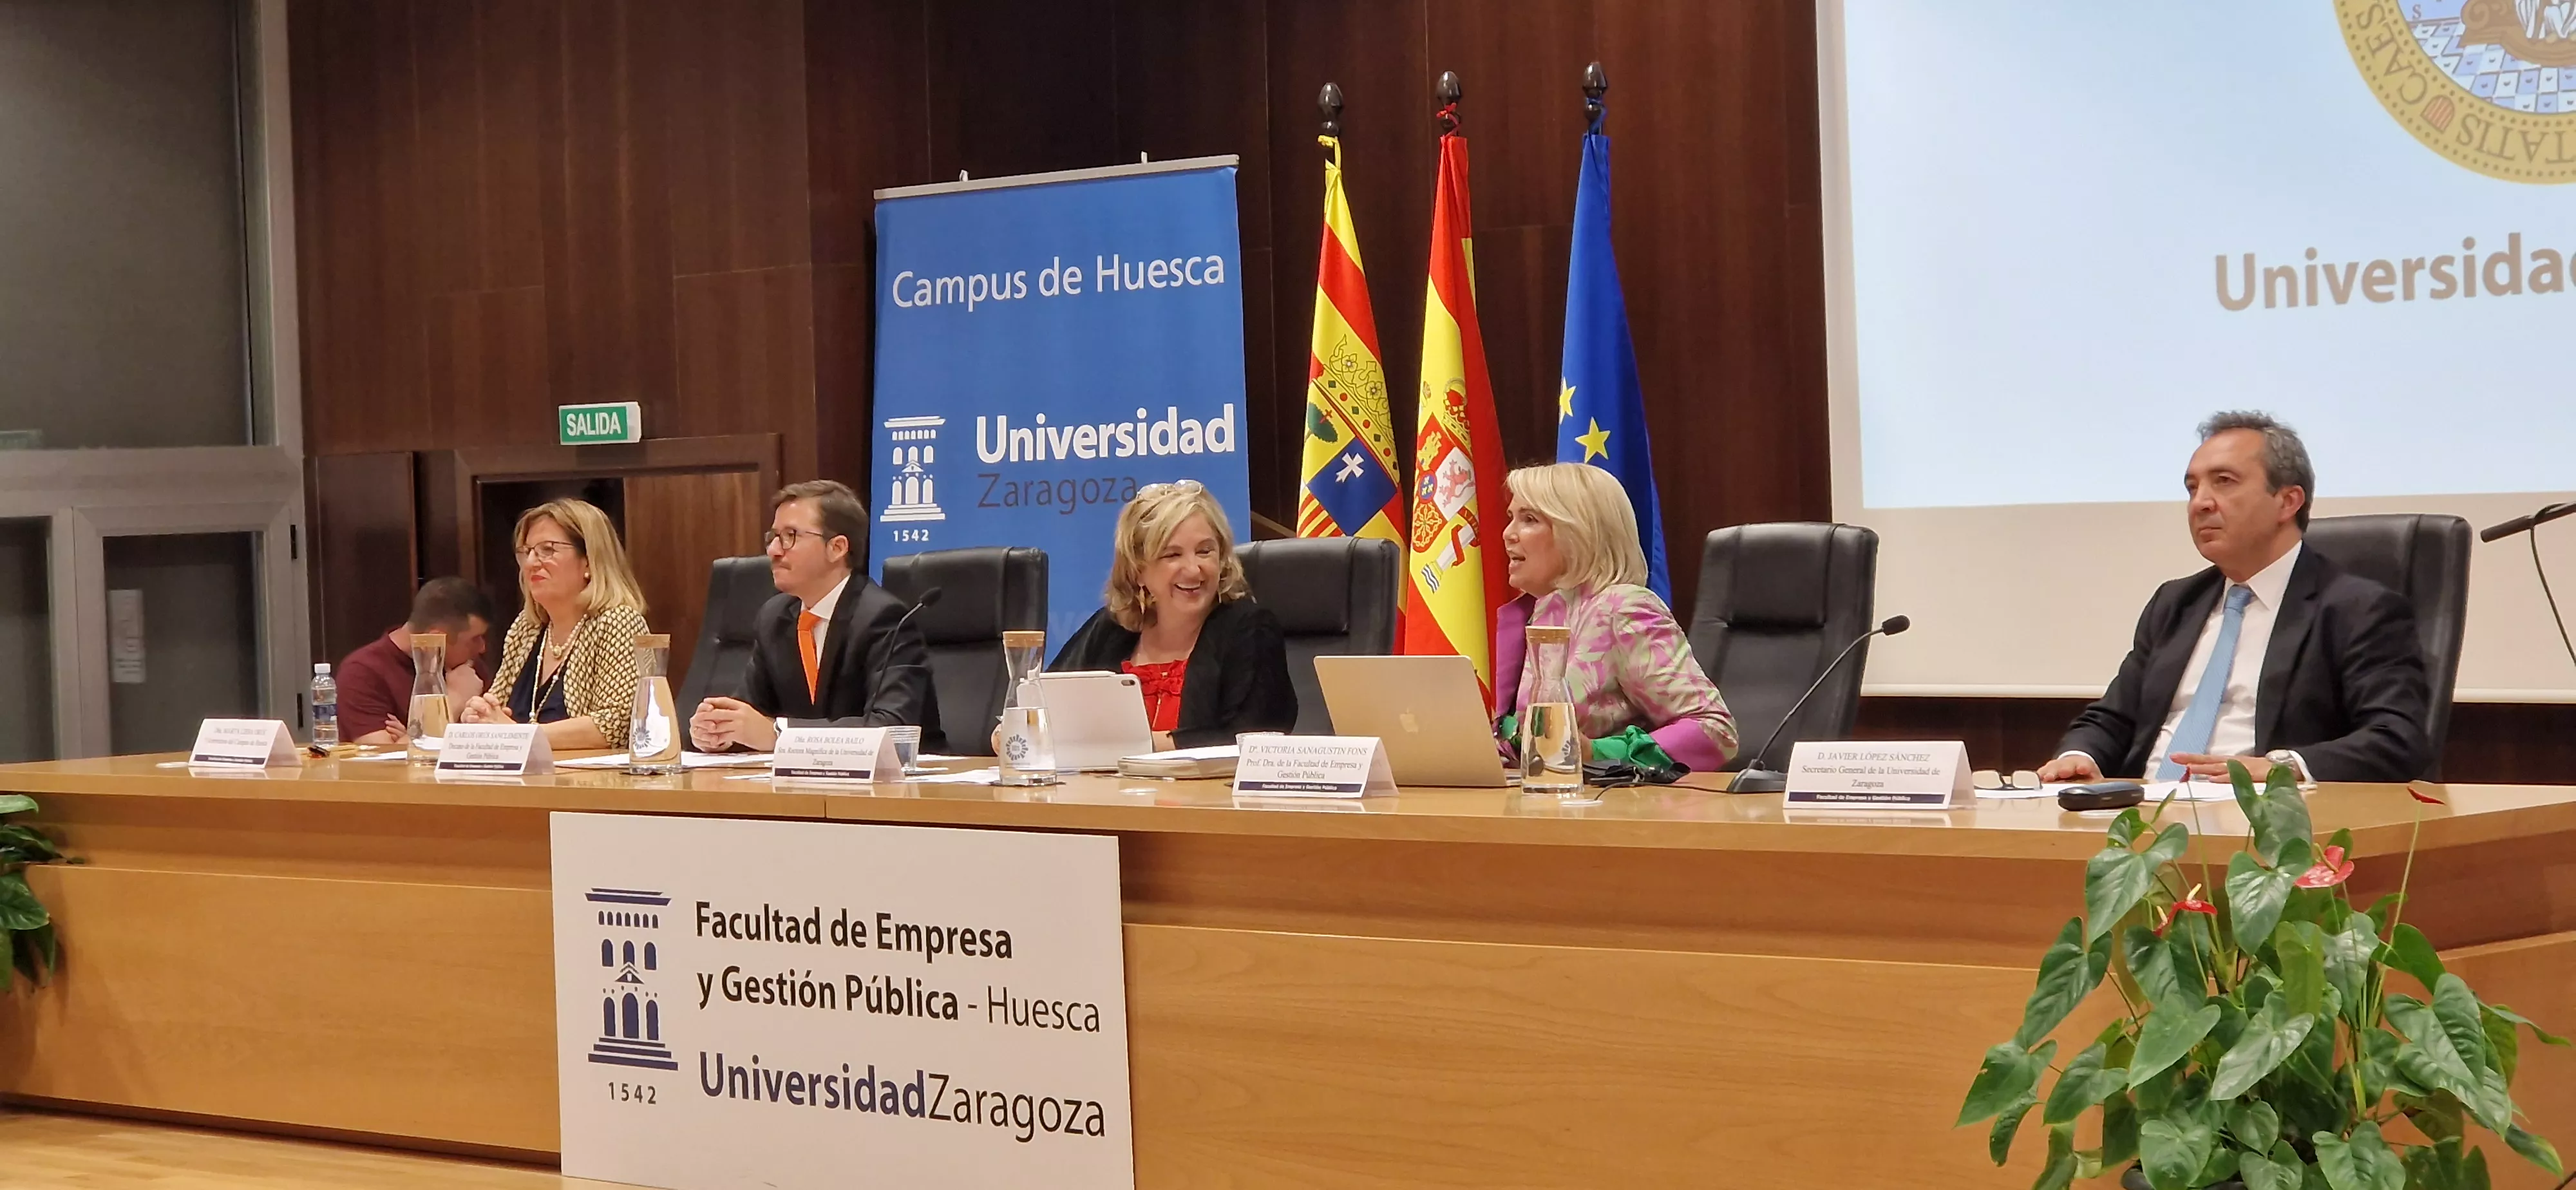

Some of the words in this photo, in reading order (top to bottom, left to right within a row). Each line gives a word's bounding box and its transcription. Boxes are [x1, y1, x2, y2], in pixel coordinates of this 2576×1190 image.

[893, 270, 1027, 312] Campus
[1038, 256, 1083, 297] de
[1097, 254, 1224, 292] Huesca
[2215, 232, 2576, 311] Universida
[566, 411, 621, 437] SALIDA
[976, 403, 1235, 464] Universidad
[978, 473, 1137, 515] Zaragoza
[893, 529, 929, 542] 1542
[1260, 746, 1295, 754] VICTORIA
[1827, 752, 1858, 760] JAVIER
[1859, 751, 1888, 761] LÓPEZ
[1888, 752, 1931, 762] SÁNCHEZ
[1277, 770, 1300, 779] Gestión
[1302, 771, 1325, 779] Pública
[1330, 760, 1358, 770] Empresa
[1802, 765, 1837, 773] Secretario
[1839, 766, 1866, 774] General
[1868, 766, 1877, 775] de
[1878, 766, 1884, 775] la
[1887, 767, 1930, 775] Universidad
[1852, 779, 1884, 789] Zaragoza
[696, 901, 822, 945] Facultad
[830, 908, 867, 949] de
[876, 912, 1012, 964] Empresa
[696, 970, 714, 1010] y
[721, 965, 836, 1010] Gestión
[845, 974, 958, 1021] Pública
[987, 985, 1100, 1033] Huesca
[608, 1082, 656, 1105] 1542
